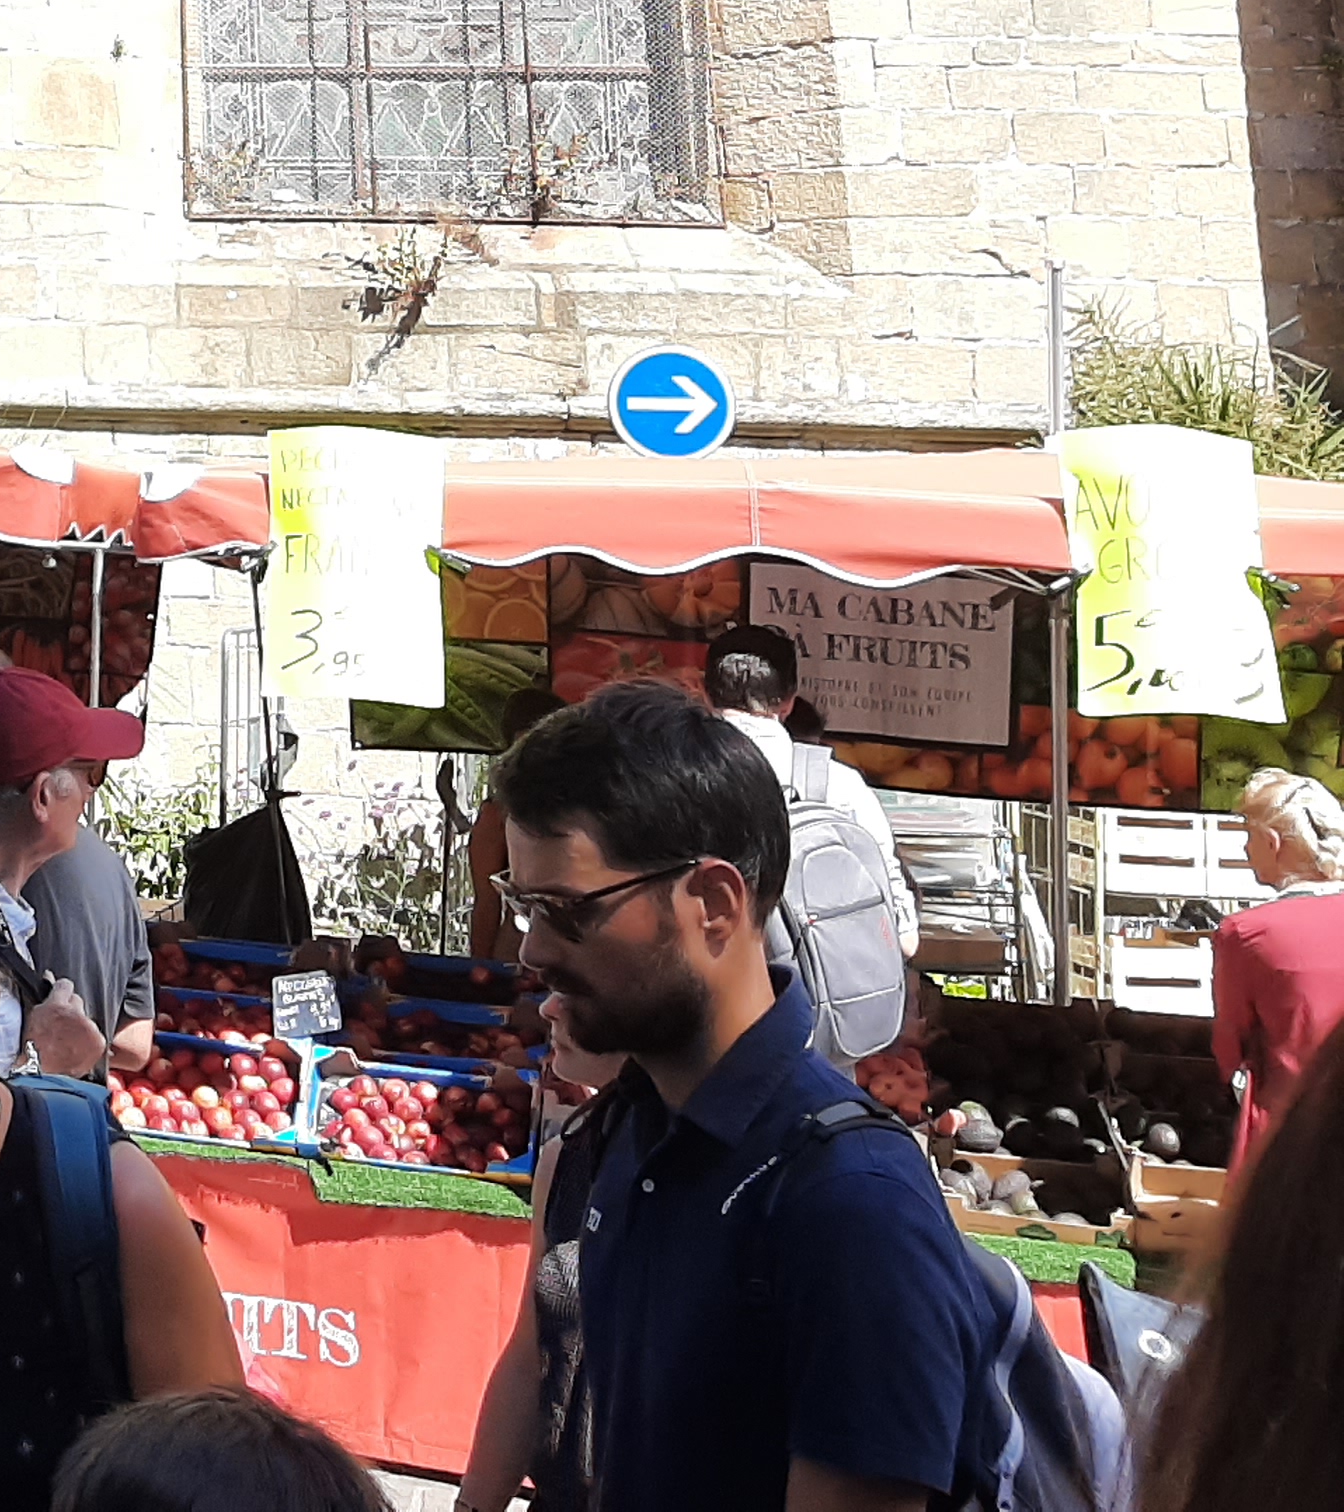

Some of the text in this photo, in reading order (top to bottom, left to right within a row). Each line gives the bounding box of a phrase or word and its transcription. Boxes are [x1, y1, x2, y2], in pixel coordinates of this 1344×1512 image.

[766, 586, 997, 633] MA CABANE
[823, 632, 972, 671] FRUITS
